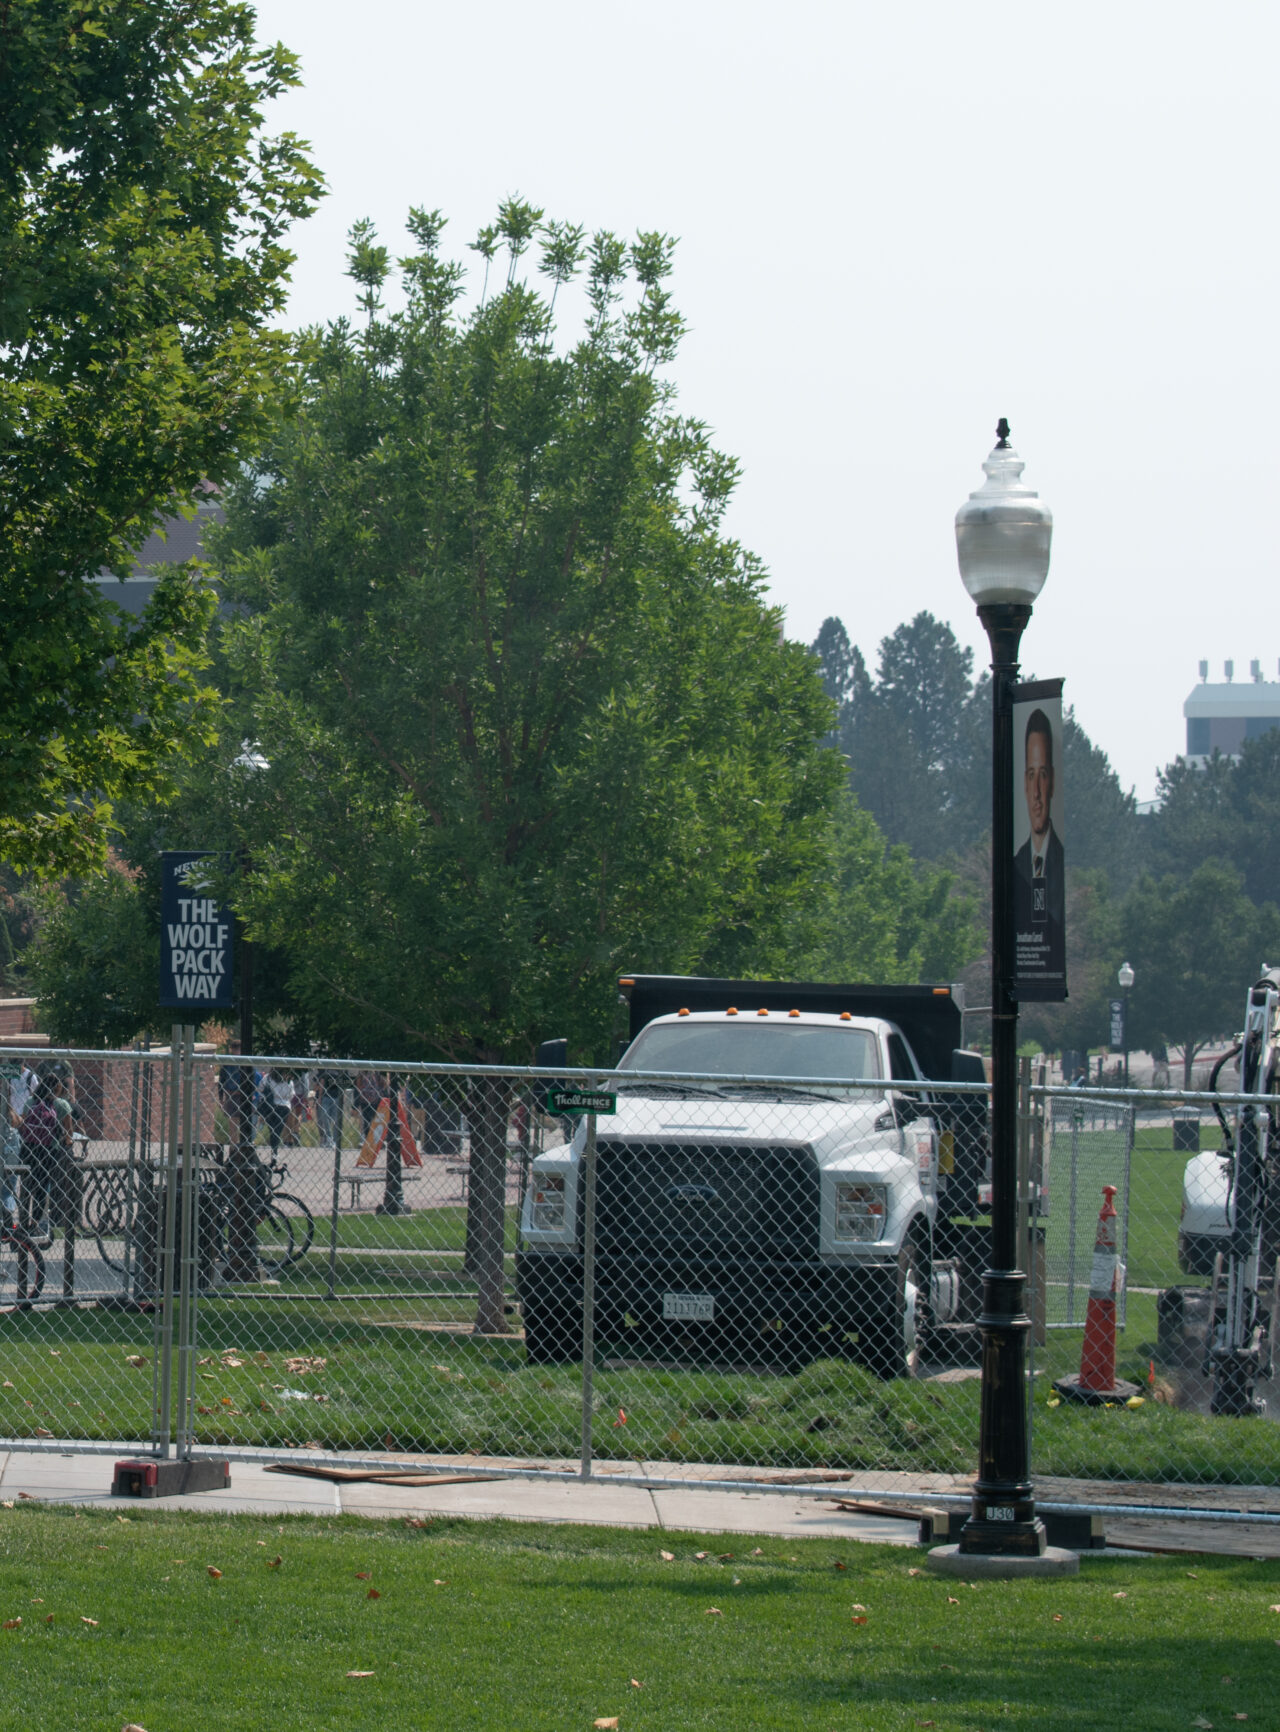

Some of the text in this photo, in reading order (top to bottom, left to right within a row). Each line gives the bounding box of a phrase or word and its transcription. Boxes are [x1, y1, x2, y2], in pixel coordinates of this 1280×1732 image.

[178, 898, 219, 923] THE
[1033, 887, 1045, 911] N
[167, 924, 229, 948] WOLF
[171, 949, 226, 974] PACK
[174, 975, 222, 999] WAY
[555, 1093, 611, 1106] Tholl FENCE
[987, 1507, 1014, 1520] J30
